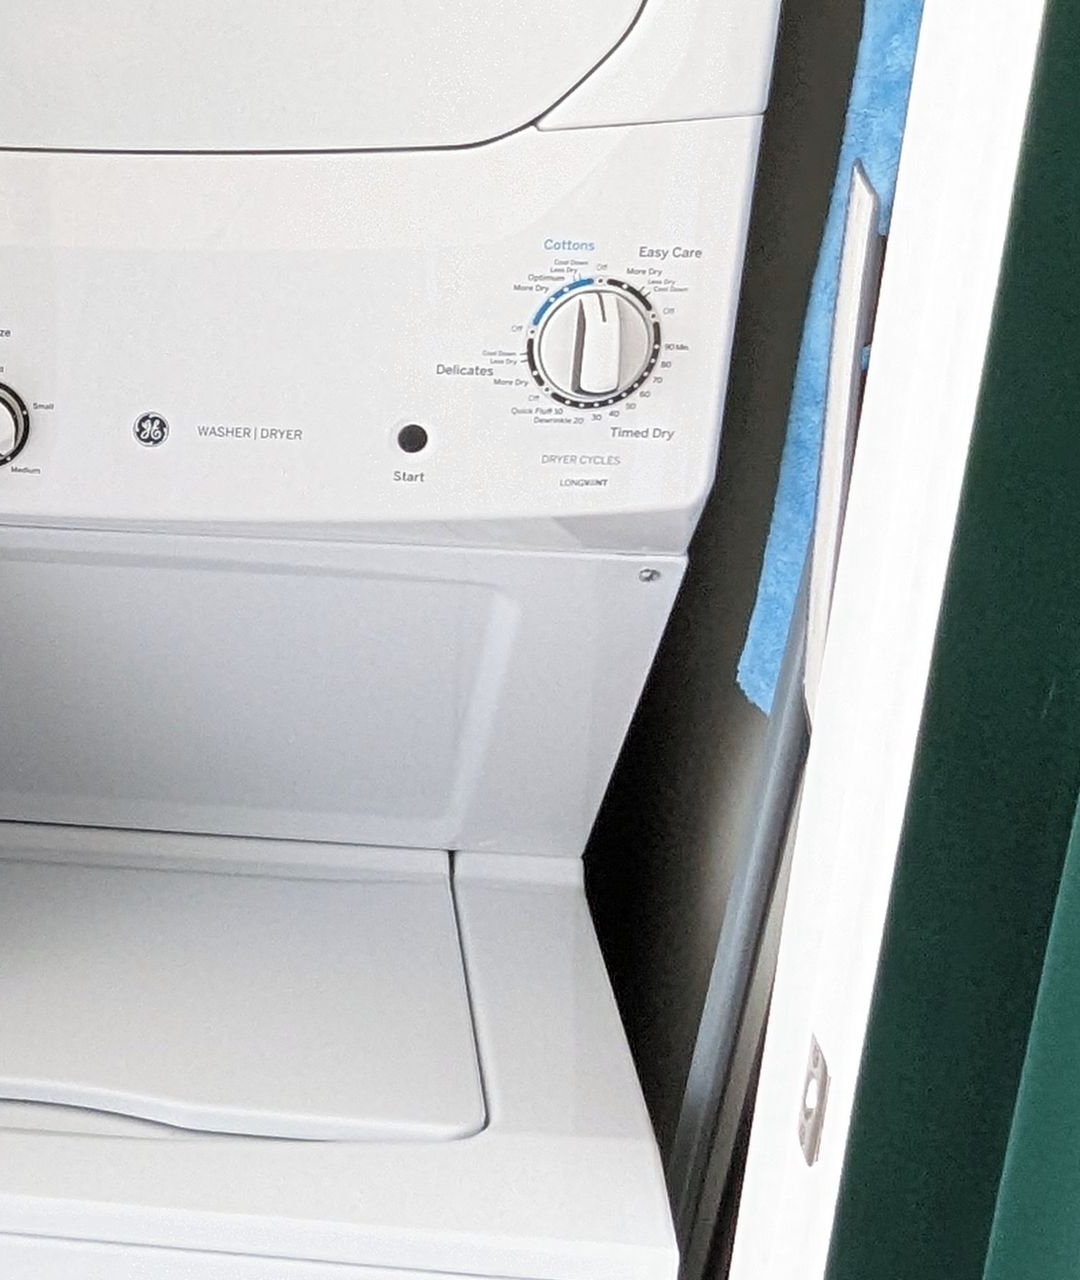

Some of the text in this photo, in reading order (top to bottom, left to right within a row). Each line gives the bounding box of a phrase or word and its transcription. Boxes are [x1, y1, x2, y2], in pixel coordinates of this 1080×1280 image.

[544, 239, 595, 251] Cottons
[639, 246, 702, 260] Easy Care
[648, 268, 662, 277] Dry
[535, 285, 549, 293] Dry
[436, 364, 493, 376] Delicates
[515, 379, 529, 387] Dry
[198, 426, 251, 438] WASHER
[261, 428, 302, 440] DRYER
[611, 427, 675, 440] Timed Dry
[542, 455, 621, 465] DRYER CYCLES
[394, 471, 424, 482] Start
